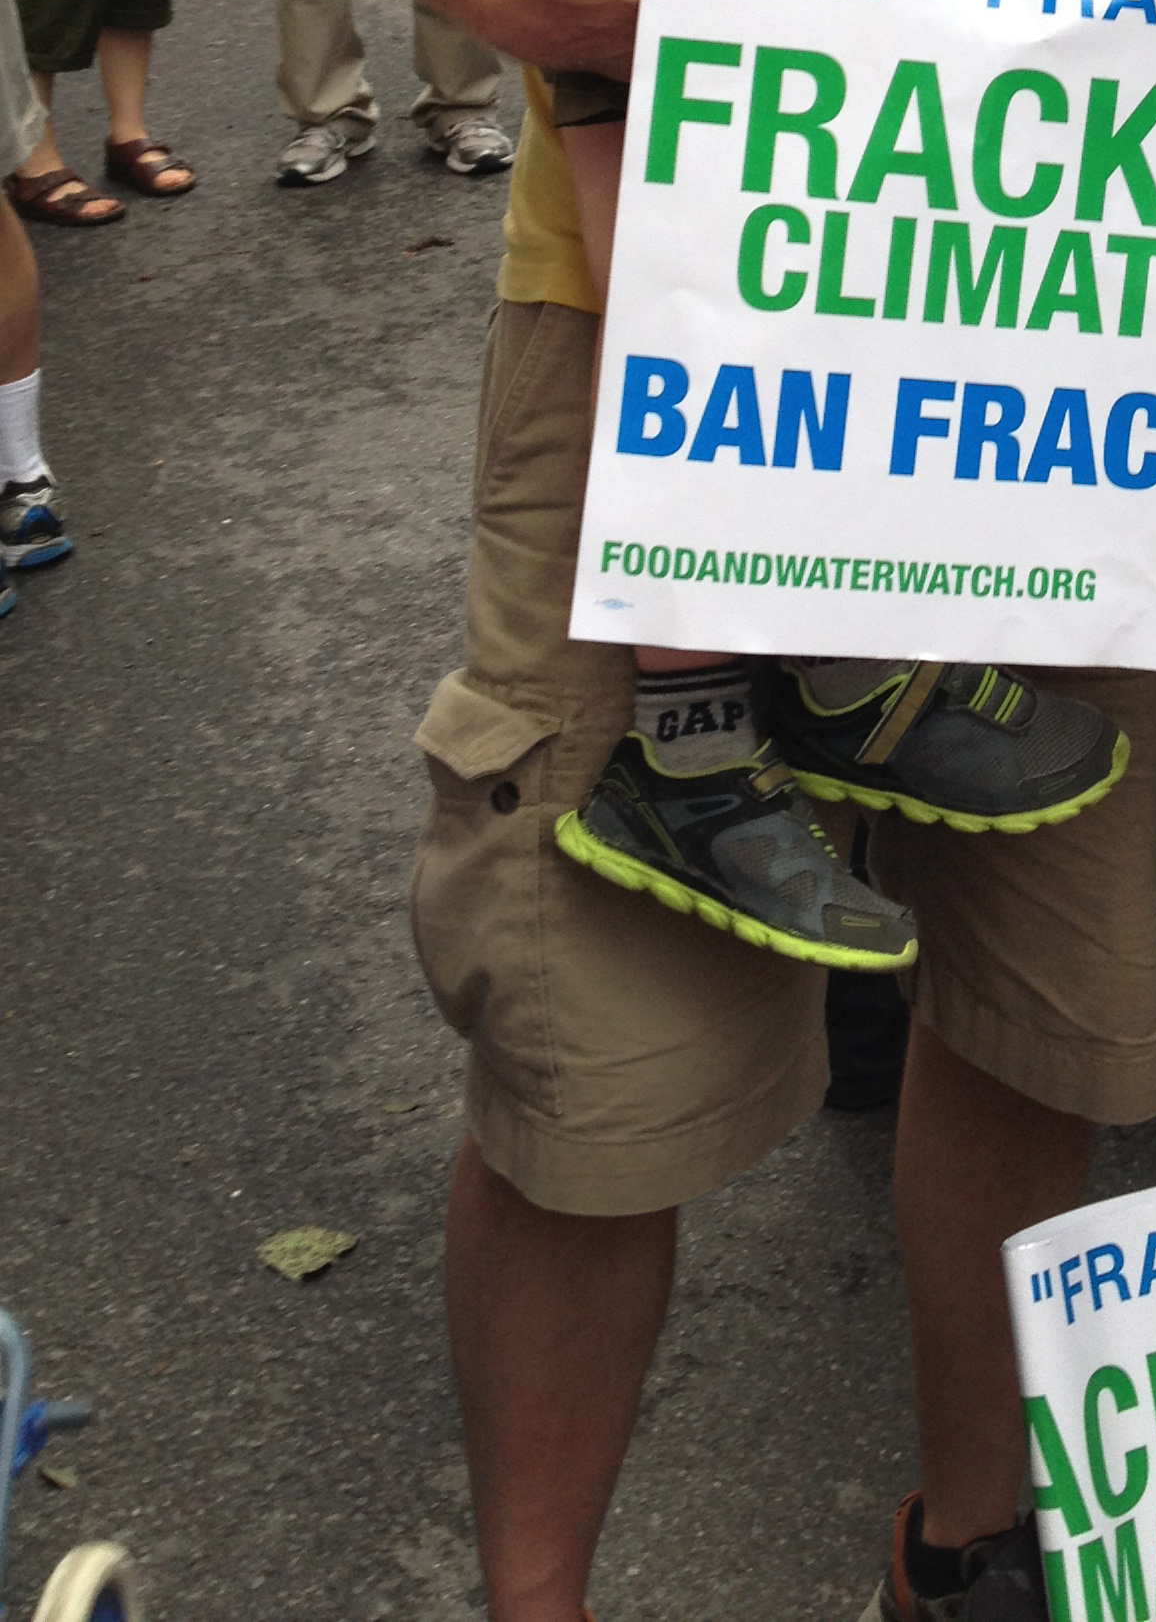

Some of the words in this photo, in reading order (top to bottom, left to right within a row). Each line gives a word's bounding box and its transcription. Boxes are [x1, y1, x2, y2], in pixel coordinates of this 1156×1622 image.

[615, 354, 851, 473] BAN
[600, 541, 1097, 601] FOODANDWATERWATCH.ORG
[656, 698, 744, 744] GAP
